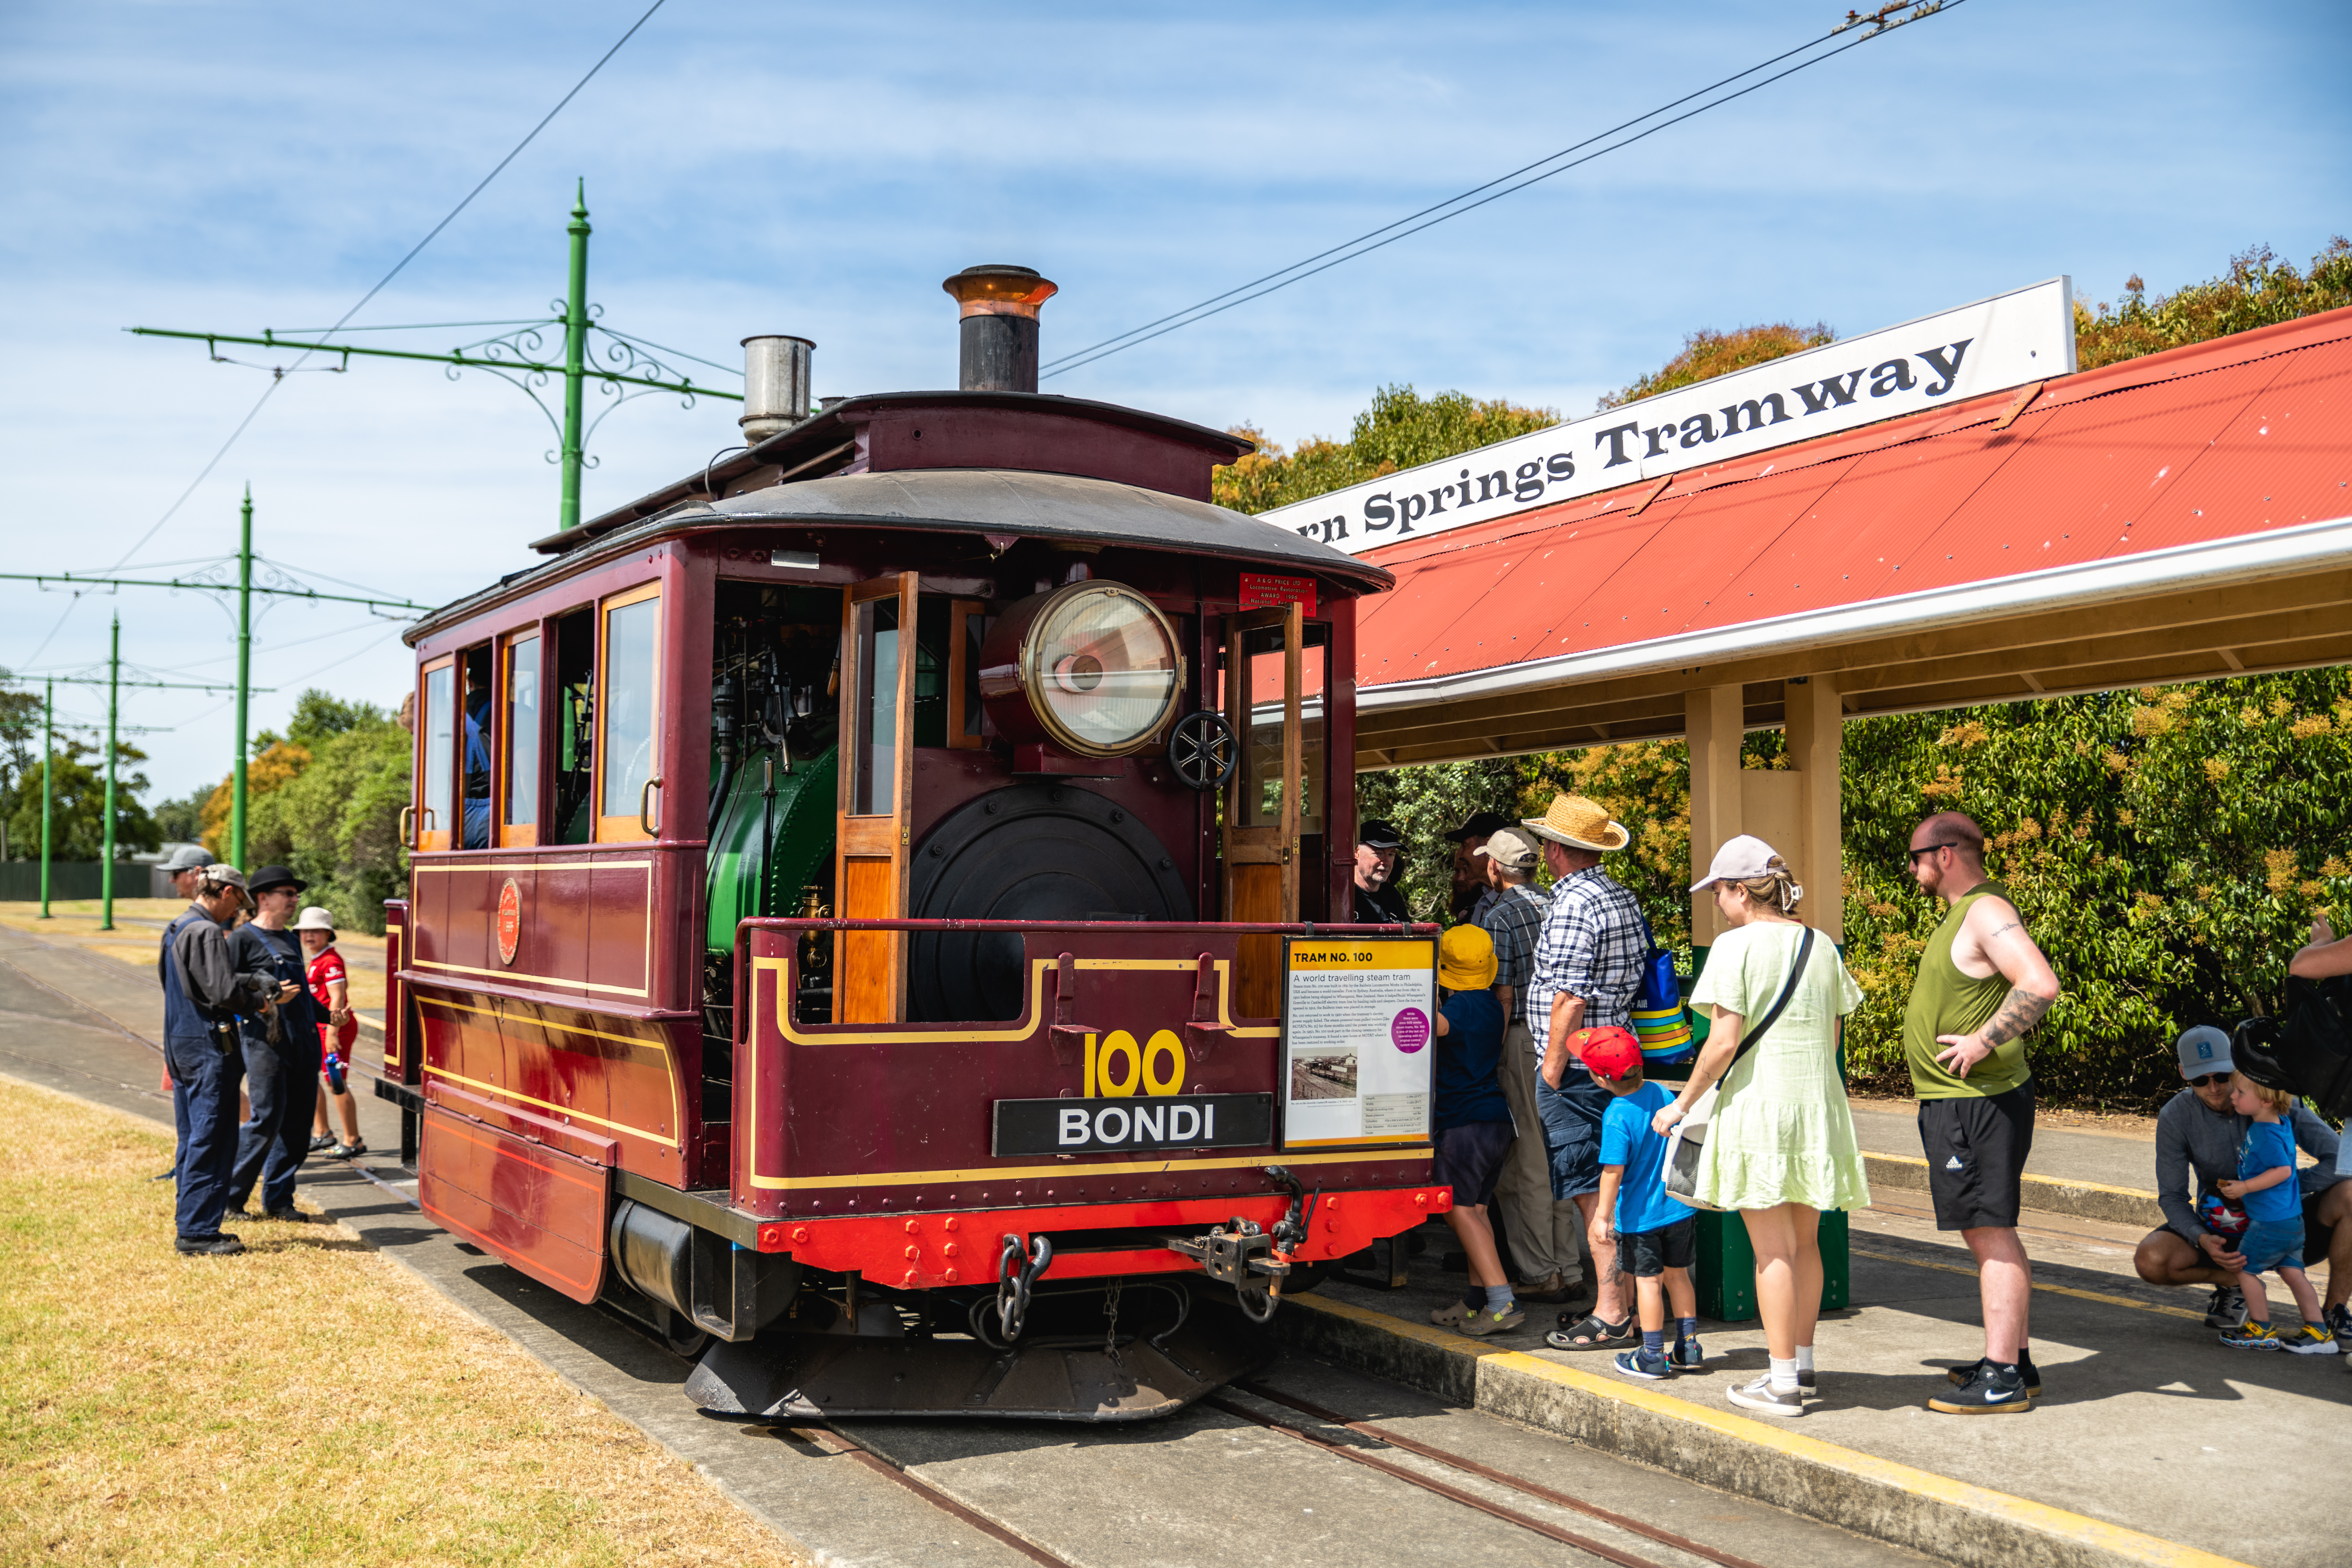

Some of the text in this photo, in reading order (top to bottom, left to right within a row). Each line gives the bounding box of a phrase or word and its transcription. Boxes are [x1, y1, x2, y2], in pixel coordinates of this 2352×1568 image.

[1364, 451, 1575, 535] Springs
[1595, 338, 1974, 470] Tramway
[1294, 953, 1372, 962] TRAM NO. 100
[1328, 974, 1364, 983] travelling
[1084, 1029, 1186, 1099] 100
[1058, 1104, 1214, 1145] BONDI
